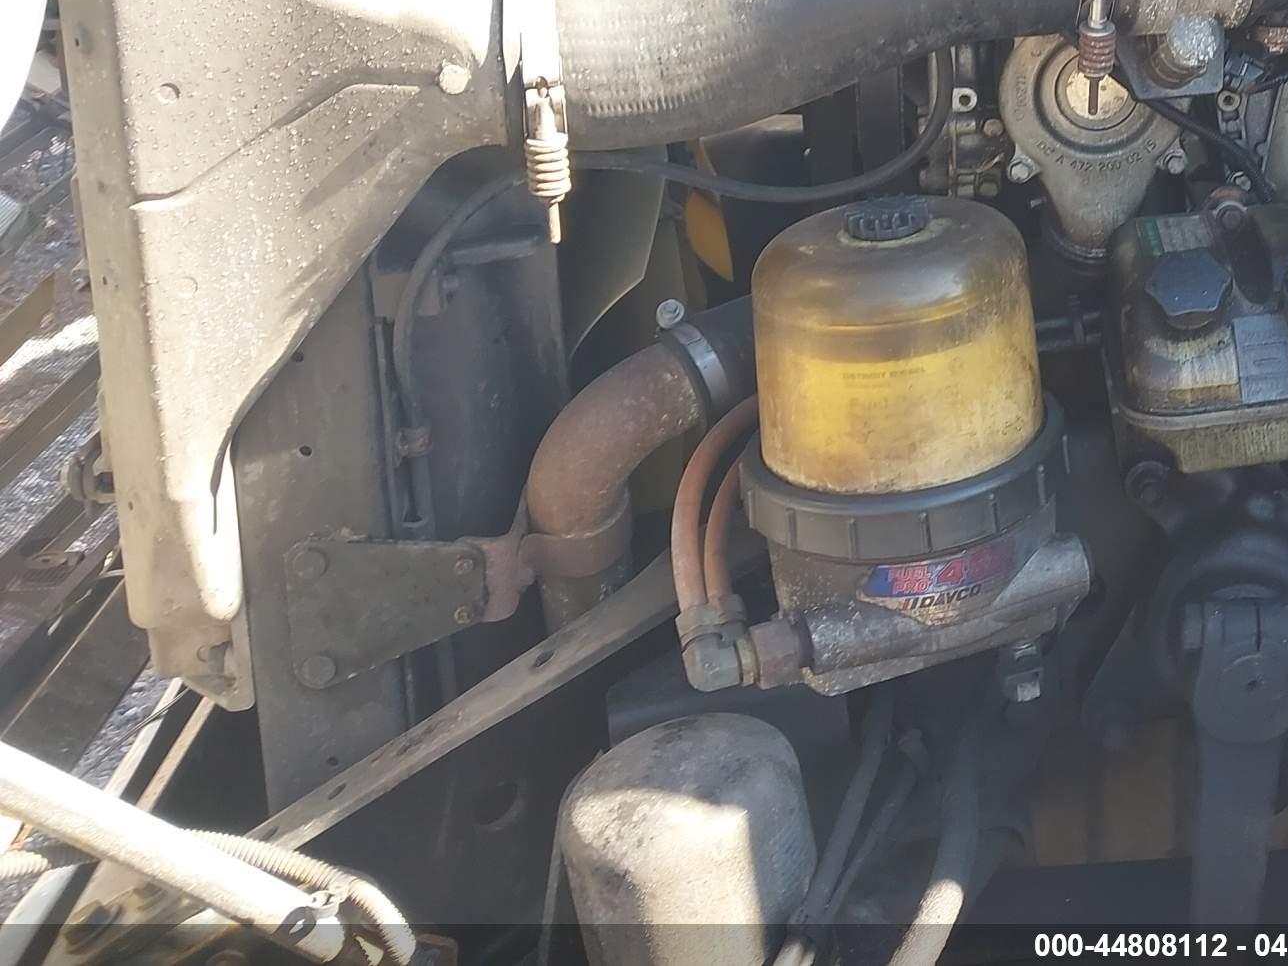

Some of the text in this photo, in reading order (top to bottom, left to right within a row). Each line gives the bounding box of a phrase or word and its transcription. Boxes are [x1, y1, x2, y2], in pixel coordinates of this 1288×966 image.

[1069, 160, 1093, 171] 472
[888, 565, 930, 582] FUEL
[892, 579, 929, 595] PRO
